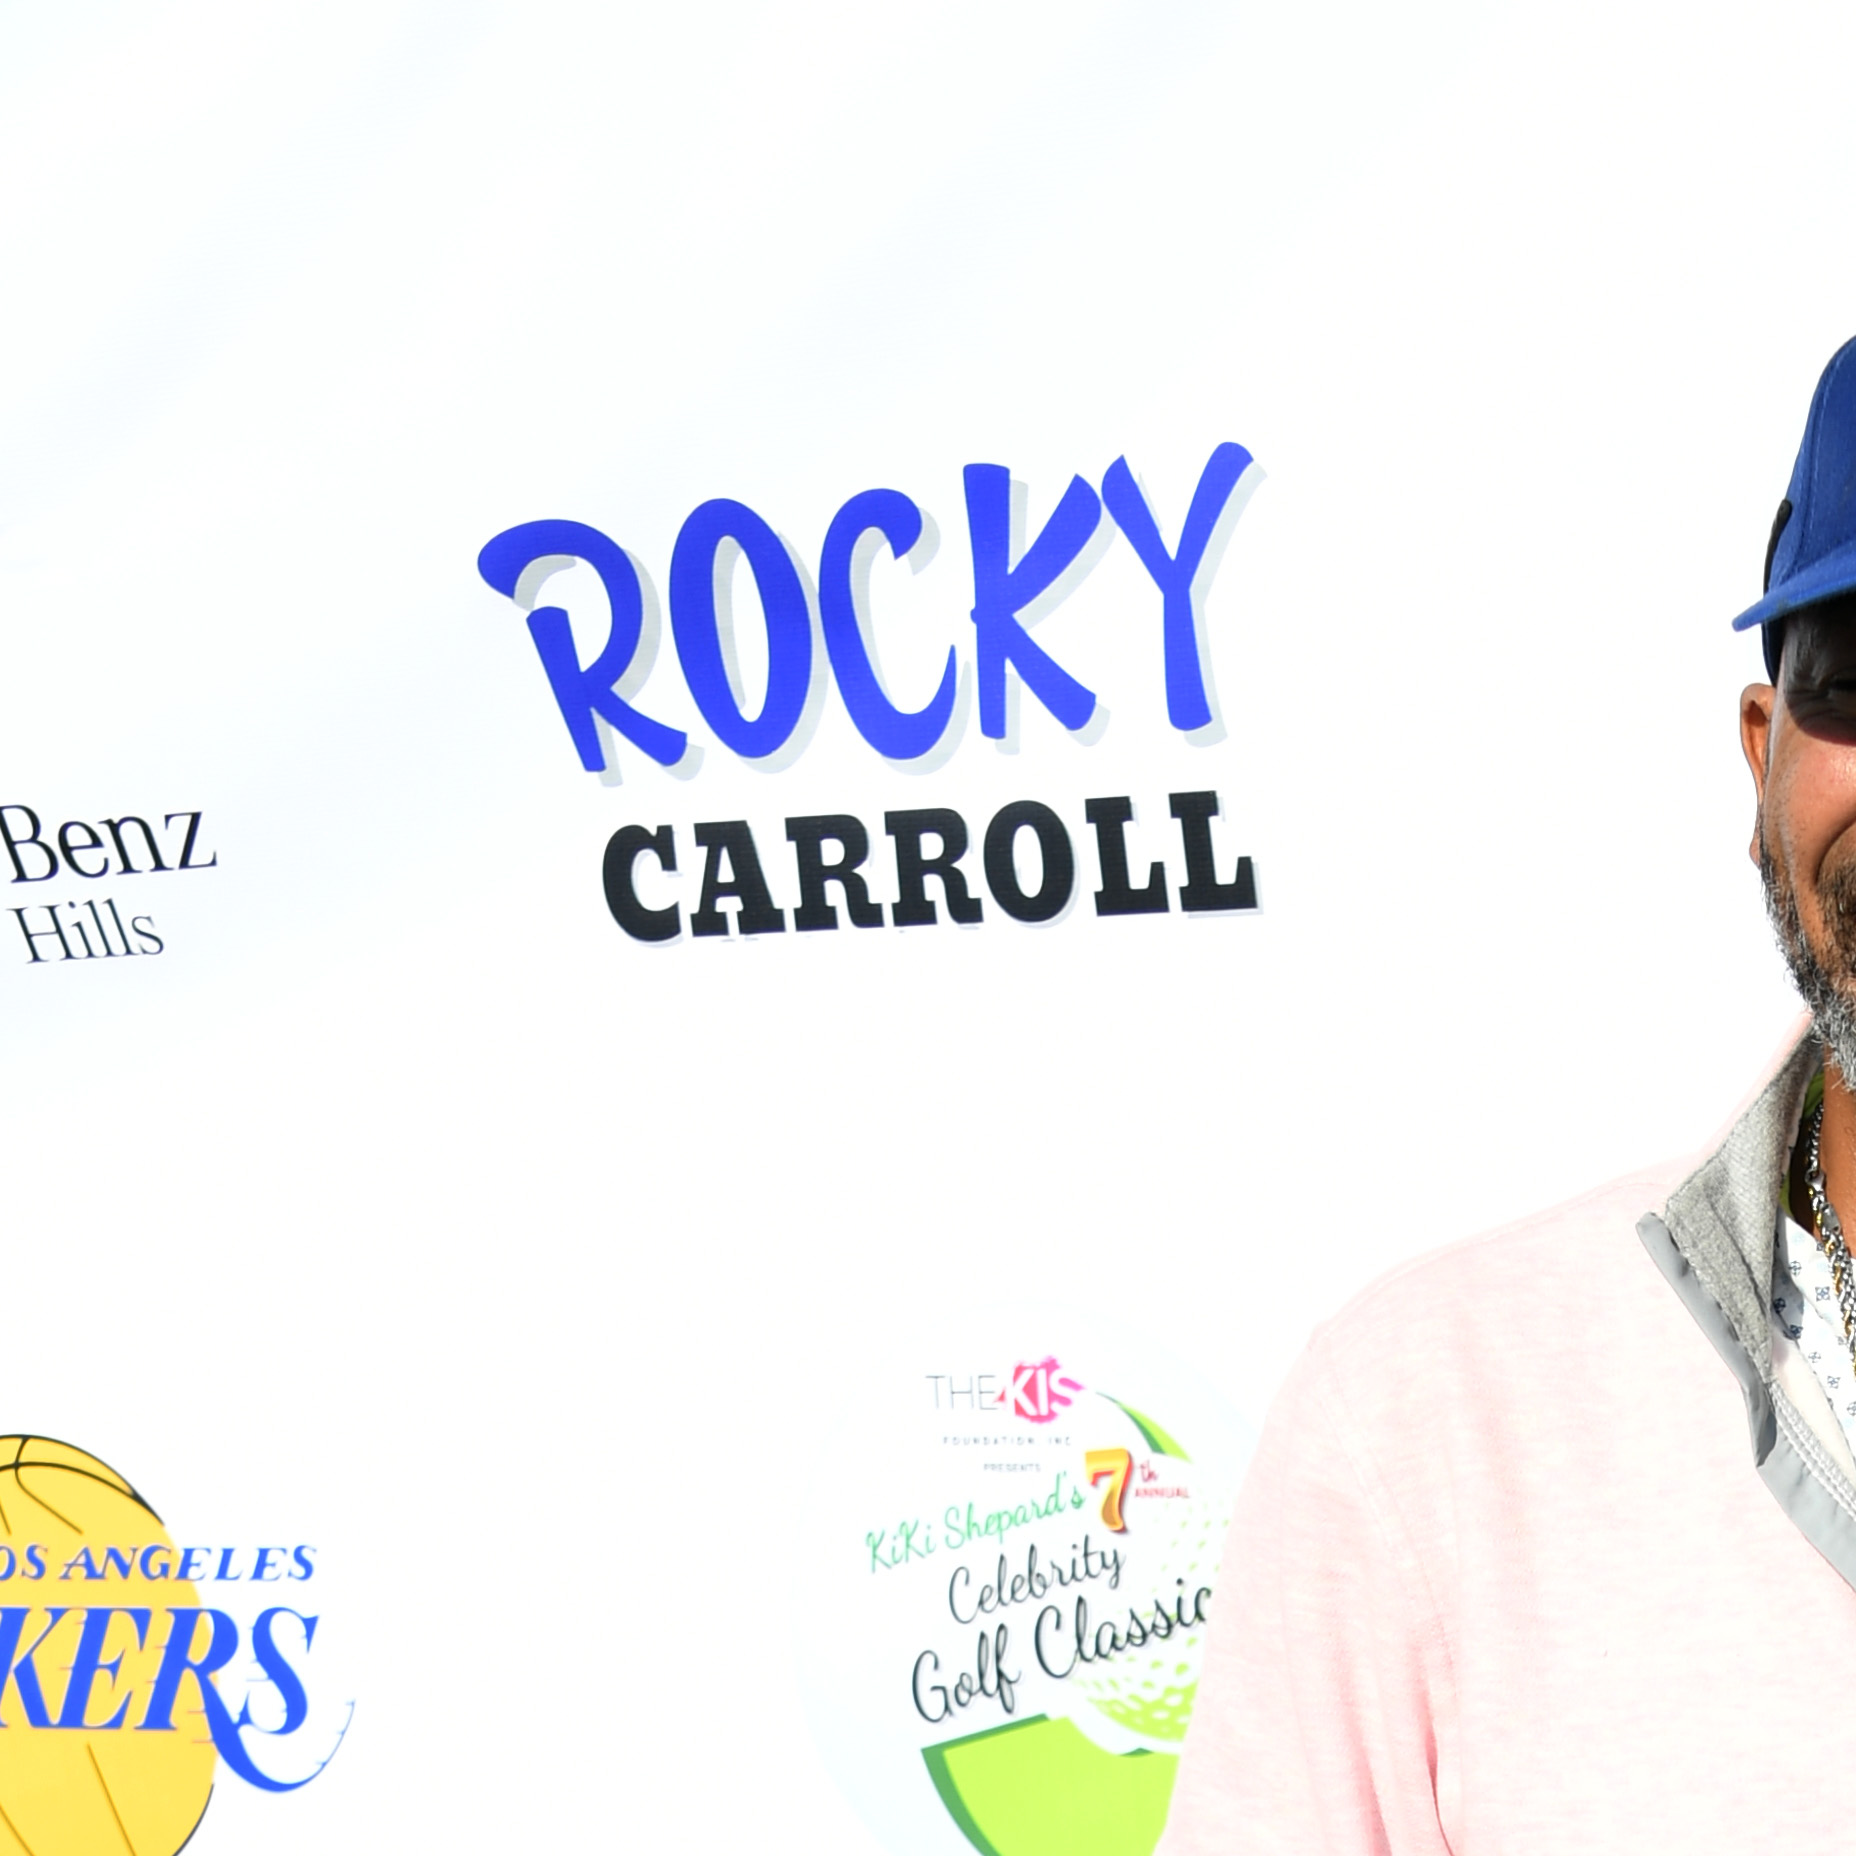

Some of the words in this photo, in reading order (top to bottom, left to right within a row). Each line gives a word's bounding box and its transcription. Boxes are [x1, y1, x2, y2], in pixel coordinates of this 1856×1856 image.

[477, 441, 1262, 778] ROCKY
[602, 789, 1262, 945] CARROLL
[6, 898, 165, 964] Hills
[926, 1374, 998, 1410] THE
[944, 1470, 1086, 1550] Shepard's
[58, 1545, 318, 1582] ANGELES
[948, 1534, 1125, 1625] Celebrity
[911, 1622, 1022, 1724] Golf
